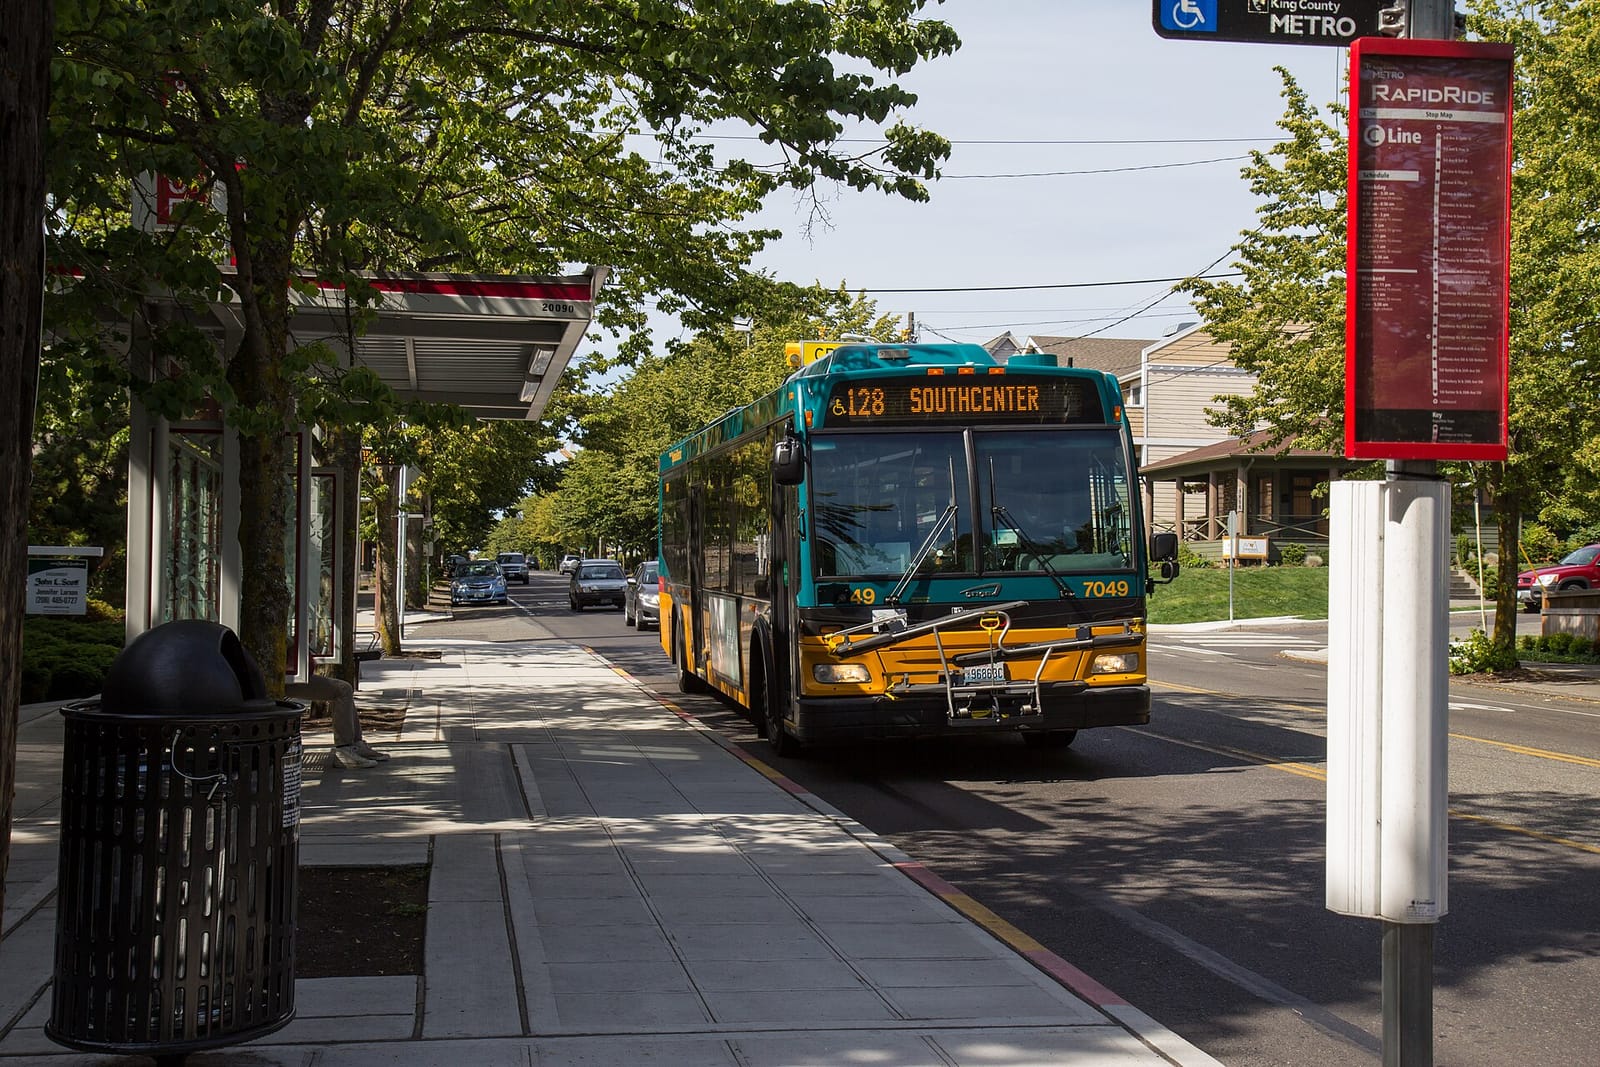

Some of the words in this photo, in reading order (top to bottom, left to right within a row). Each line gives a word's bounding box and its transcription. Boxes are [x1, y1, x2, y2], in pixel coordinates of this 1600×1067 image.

[1270, 0, 1297, 12] King
[1299, 0, 1340, 14] County
[1270, 14, 1356, 36] METRO
[1425, 111, 1440, 119] Stop
[1388, 128, 1422, 144] Line
[542, 303, 574, 313] 20090
[847, 388, 885, 416] 128
[910, 386, 1039, 413] SOUTHCENTER
[1083, 580, 1129, 598] 7049
